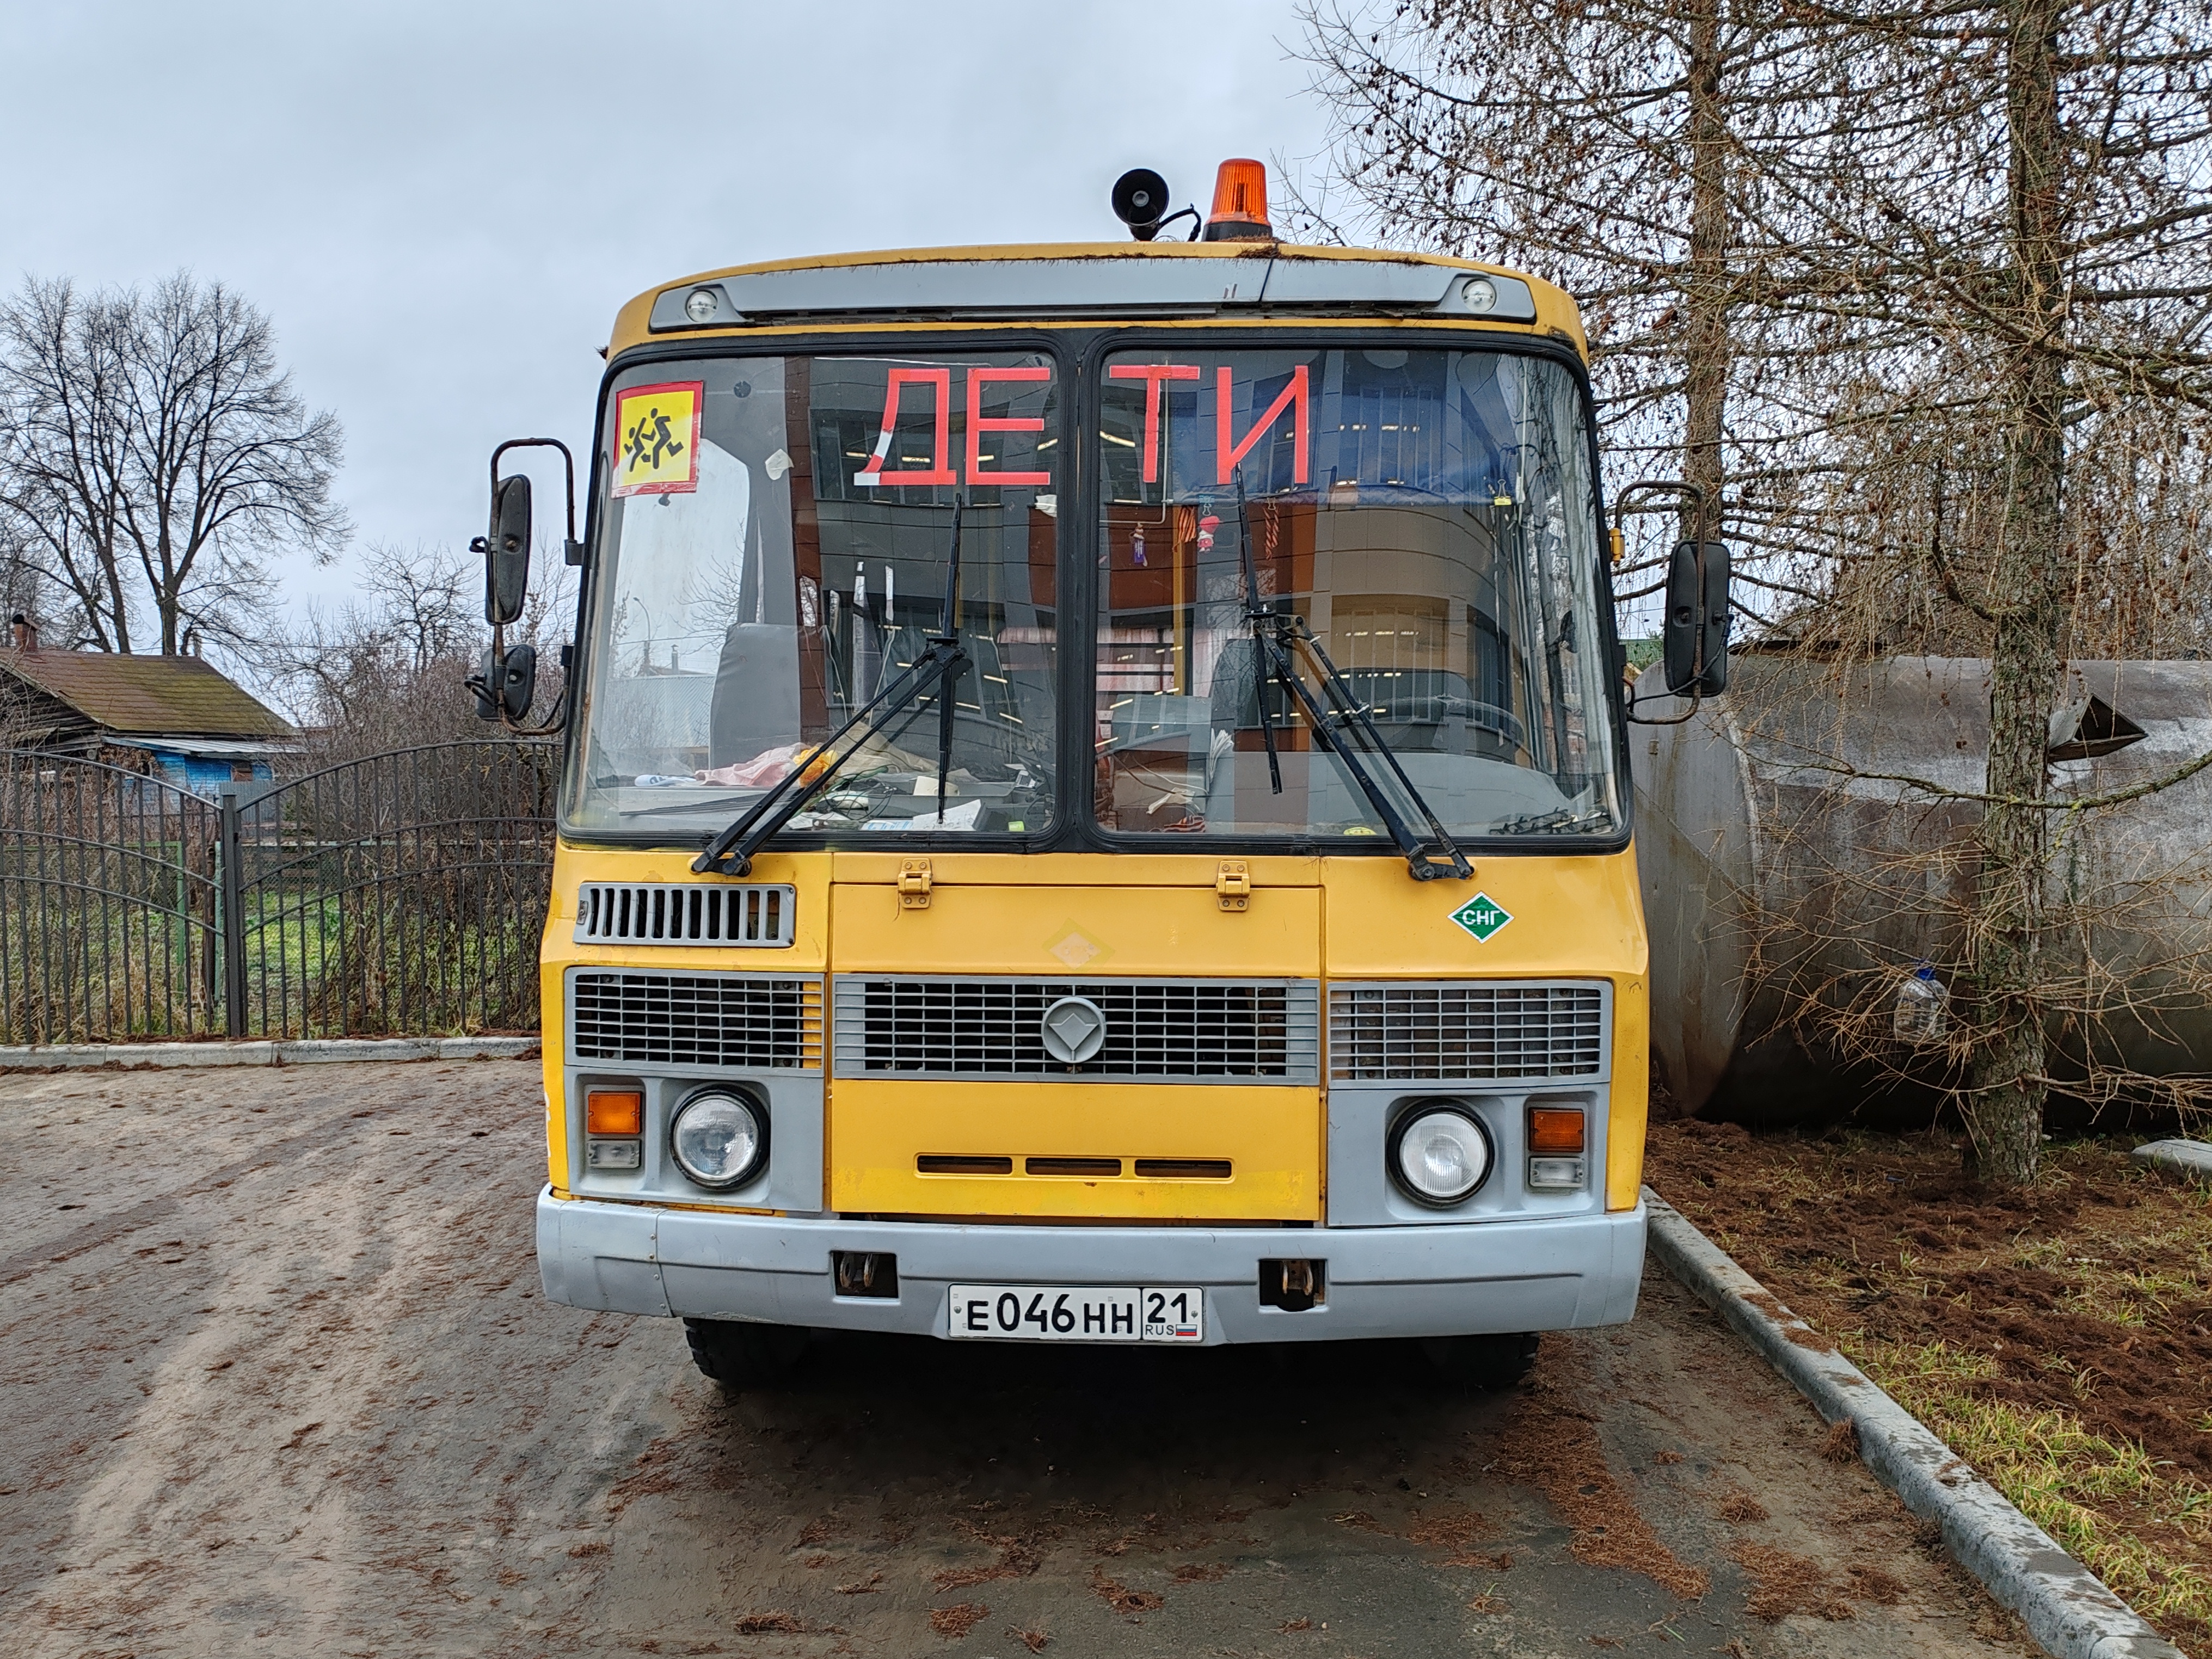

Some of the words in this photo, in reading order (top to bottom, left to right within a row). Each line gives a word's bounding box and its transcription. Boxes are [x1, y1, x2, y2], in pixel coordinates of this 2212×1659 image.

[1462, 910, 1501, 925] СНГ
[1147, 1292, 1188, 1323] 21
[1145, 1324, 1175, 1336] RUS
